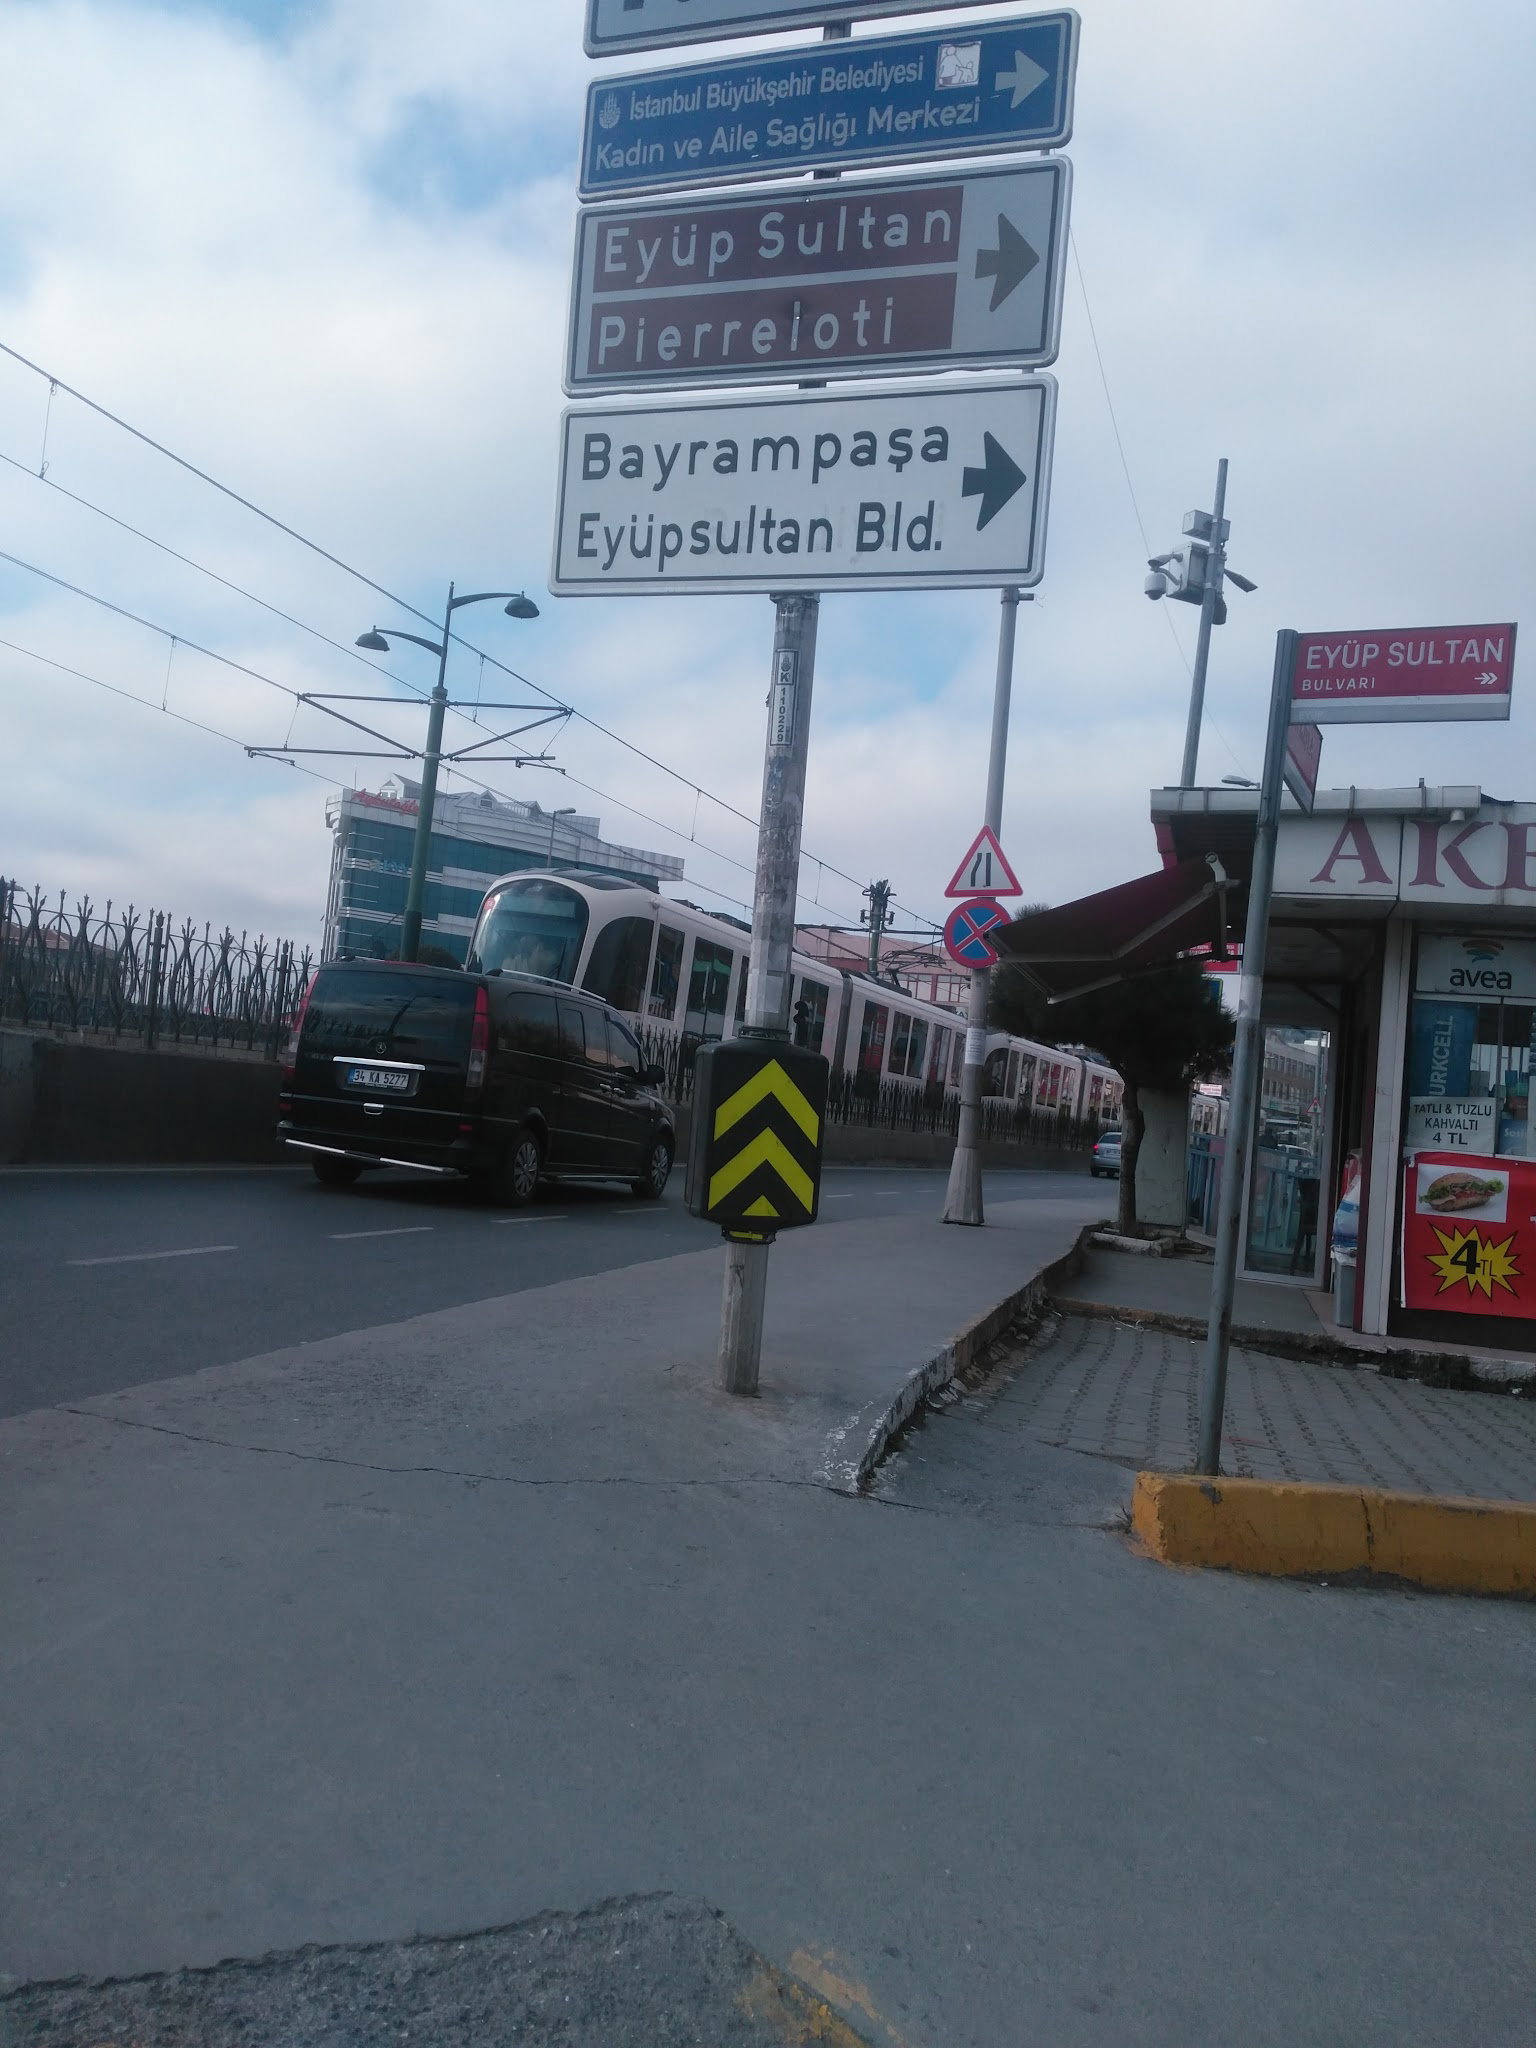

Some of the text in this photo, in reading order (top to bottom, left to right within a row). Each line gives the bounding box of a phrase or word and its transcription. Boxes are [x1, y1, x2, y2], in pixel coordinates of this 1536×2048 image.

[629, 55, 924, 121] İstanbul Büyükşehir Belediyesi
[596, 97, 981, 172] Kadın ve Aile Sağlığı Merkezi
[603, 206, 953, 283] Eyüp Sultan
[598, 297, 894, 365] Pierreloti
[581, 425, 949, 492] Bayrampaşa
[577, 500, 942, 573] Eyüpsultan Bld.
[1306, 637, 1505, 670] EYÜP SULTAN
[1301, 676, 1376, 691] BULVARI
[1449, 967, 1513, 990] avea
[355, 1070, 407, 1085] 34 KA 5277
[1413, 1103, 1493, 1117] TATLI & TUZLU
[1424, 1117, 1479, 1131] KAHVALTI
[1432, 1132, 1468, 1145] 4 TL
[1450, 1240, 1497, 1277] 4 TL
